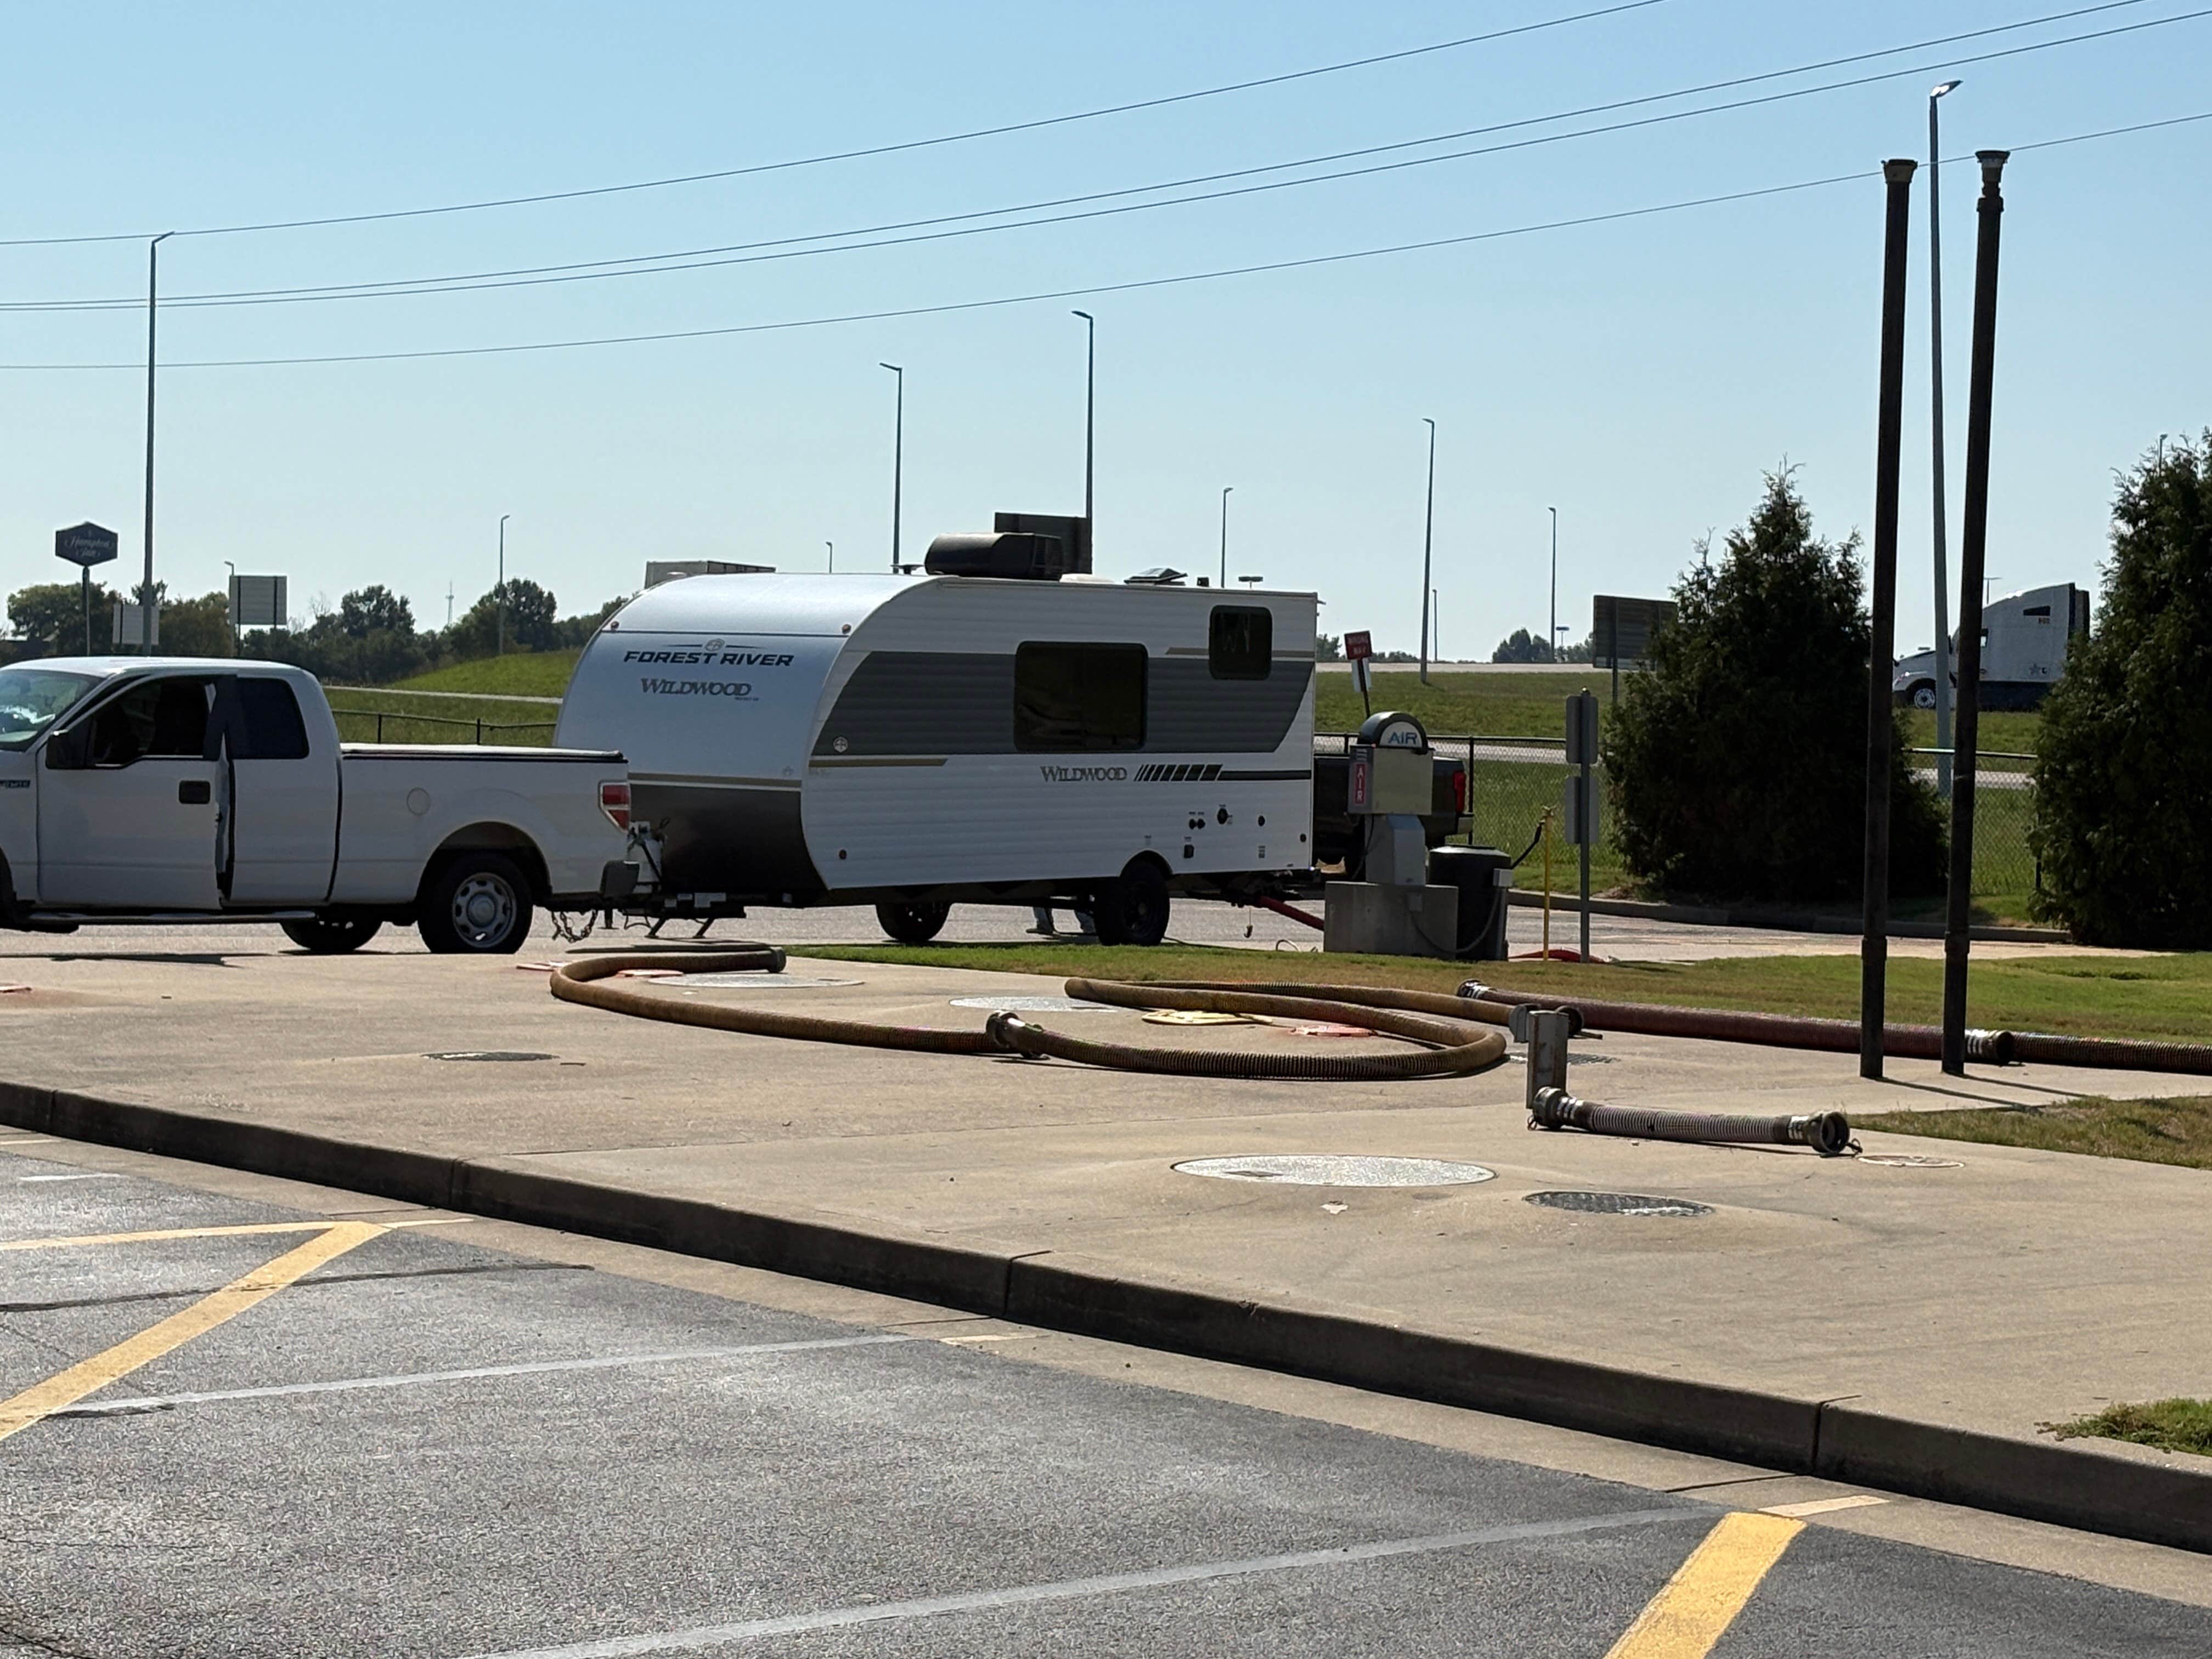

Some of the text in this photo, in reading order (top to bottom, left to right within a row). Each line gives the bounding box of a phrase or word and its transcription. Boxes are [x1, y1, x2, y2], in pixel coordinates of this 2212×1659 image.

[623, 651, 794, 666] FOREST RIVER
[640, 678, 752, 696] WILDWOOD
[1388, 731, 1418, 745] AIR
[1040, 766, 1127, 782] WILDWOOD
